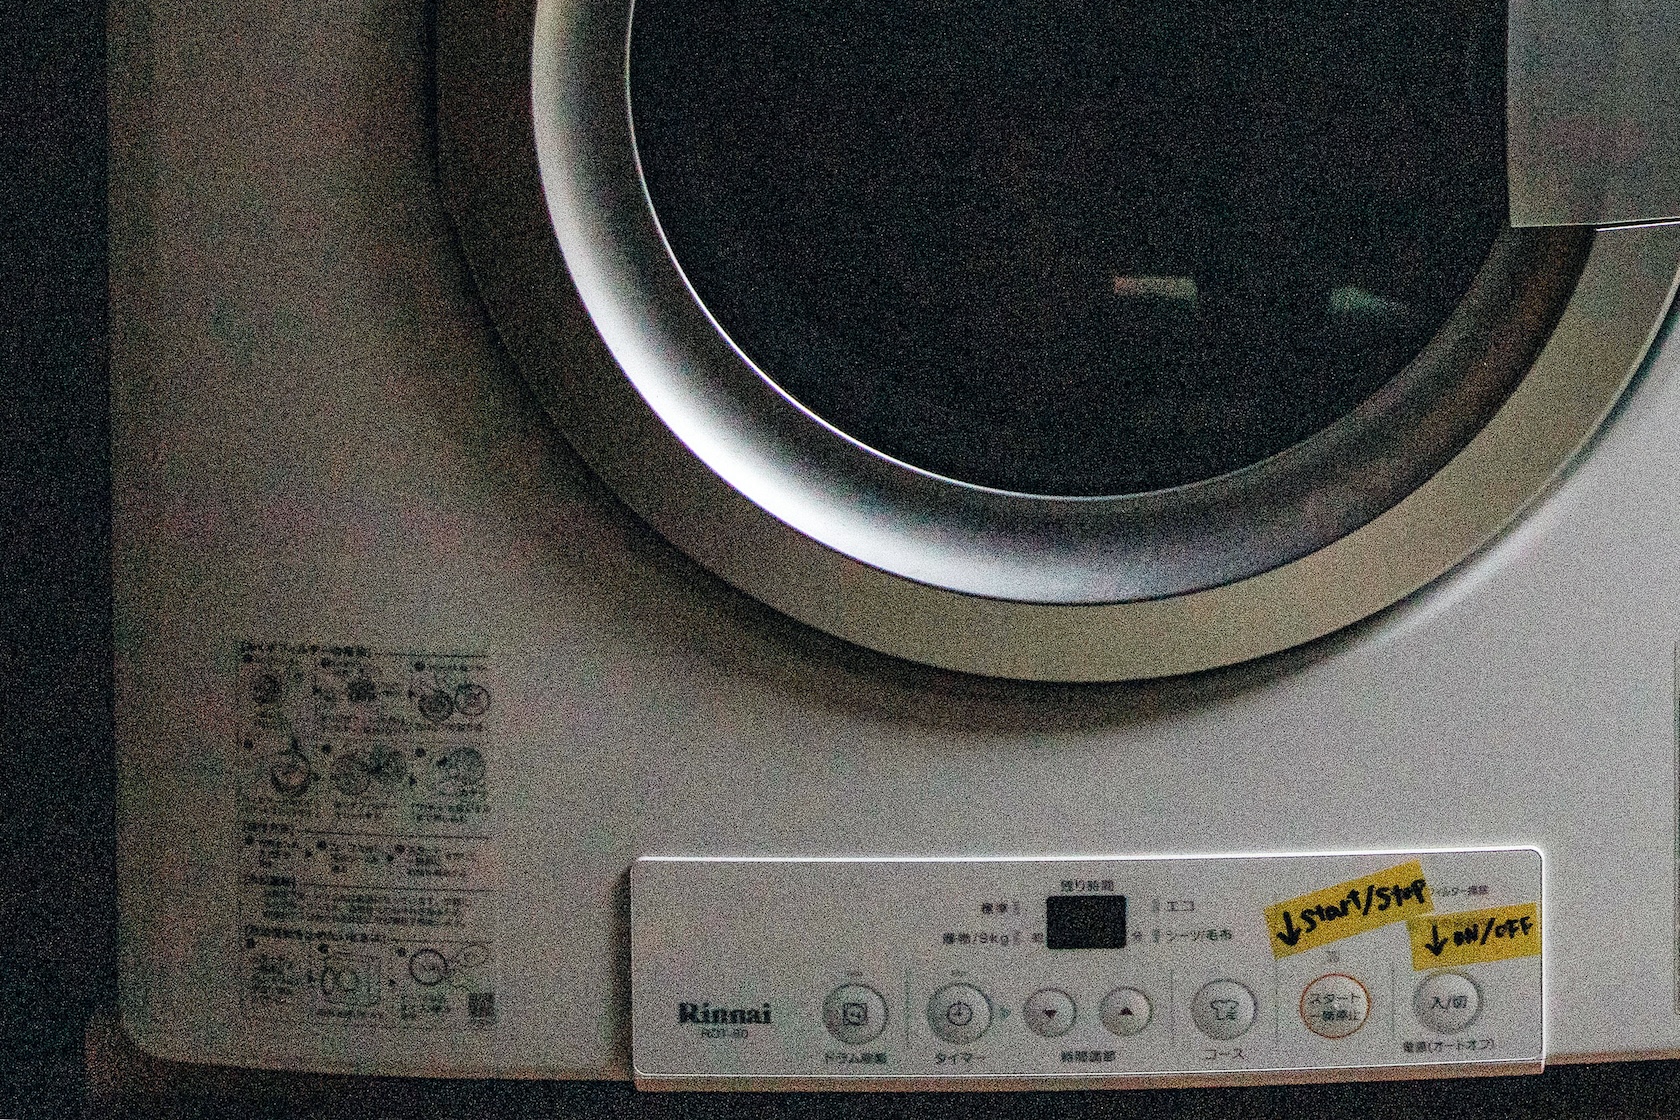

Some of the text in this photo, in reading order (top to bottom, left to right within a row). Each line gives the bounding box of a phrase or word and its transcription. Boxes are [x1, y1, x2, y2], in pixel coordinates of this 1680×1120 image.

[1310, 992, 1361, 1005] スタート
[1431, 994, 1468, 1010] 入/切
[679, 1002, 772, 1024] Rinnai
[935, 1051, 986, 1066] タイマー
[1204, 1047, 1247, 1061] コース
